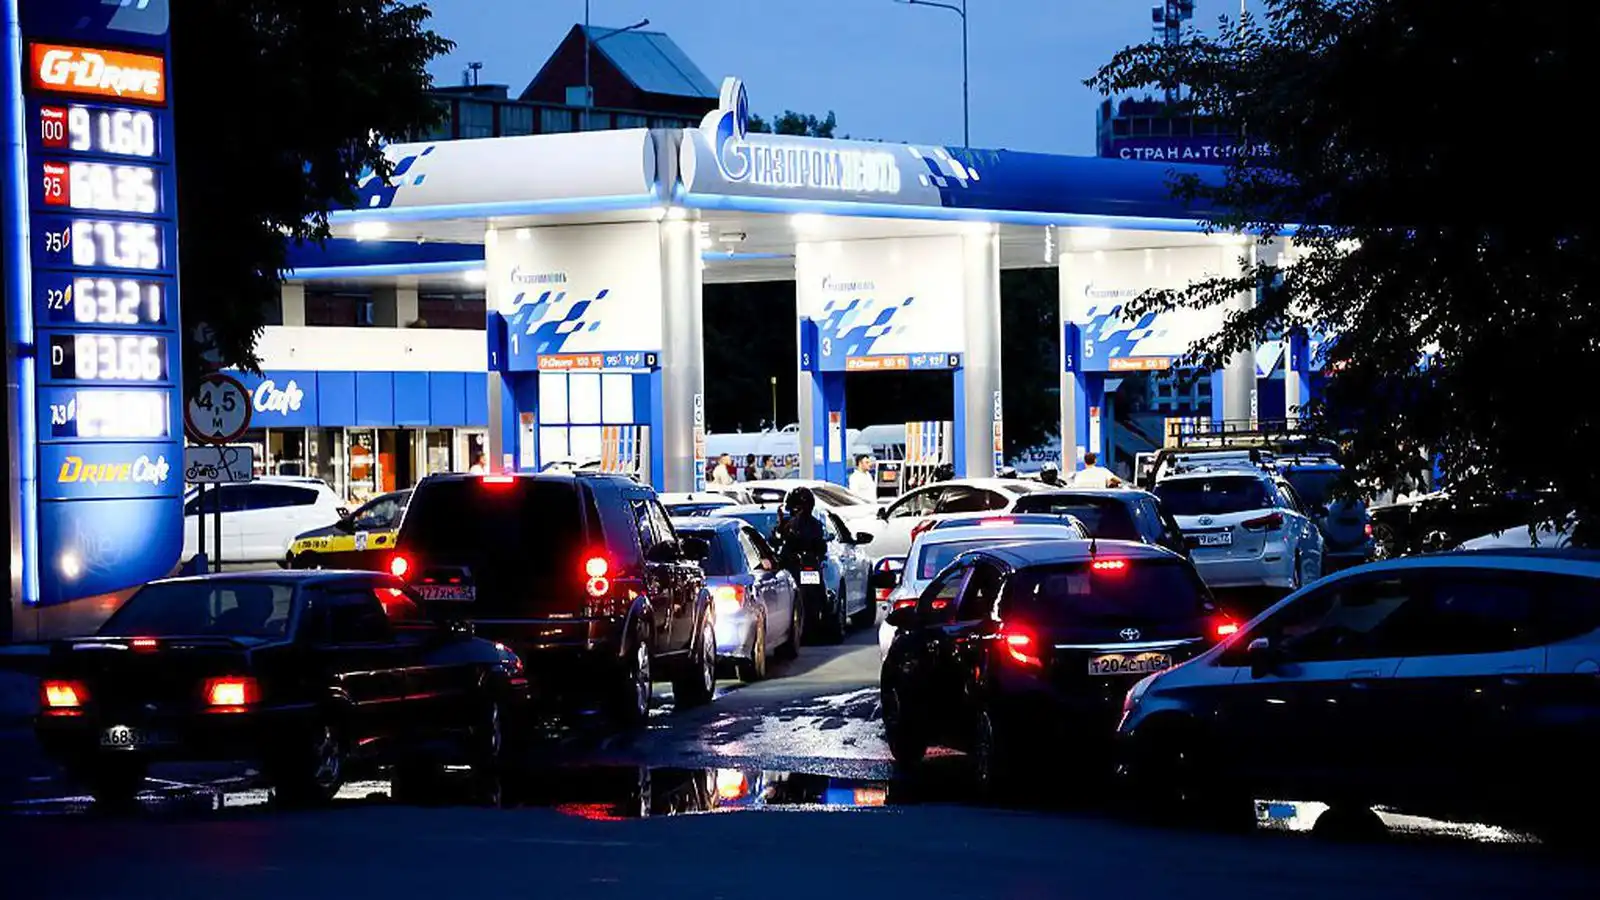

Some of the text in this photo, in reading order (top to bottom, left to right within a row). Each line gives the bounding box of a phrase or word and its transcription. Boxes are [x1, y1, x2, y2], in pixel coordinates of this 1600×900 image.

[42, 106, 154, 157] 100 91.60
[44, 176, 61, 196] 95
[74, 279, 160, 324] 63.21
[510, 333, 519, 355] 1
[822, 337, 831, 357] 3
[1084, 339, 1094, 358] 5
[52, 345, 63, 365] D
[648, 354, 655, 365] D
[803, 353, 809, 365] 3
[950, 355, 958, 365] D
